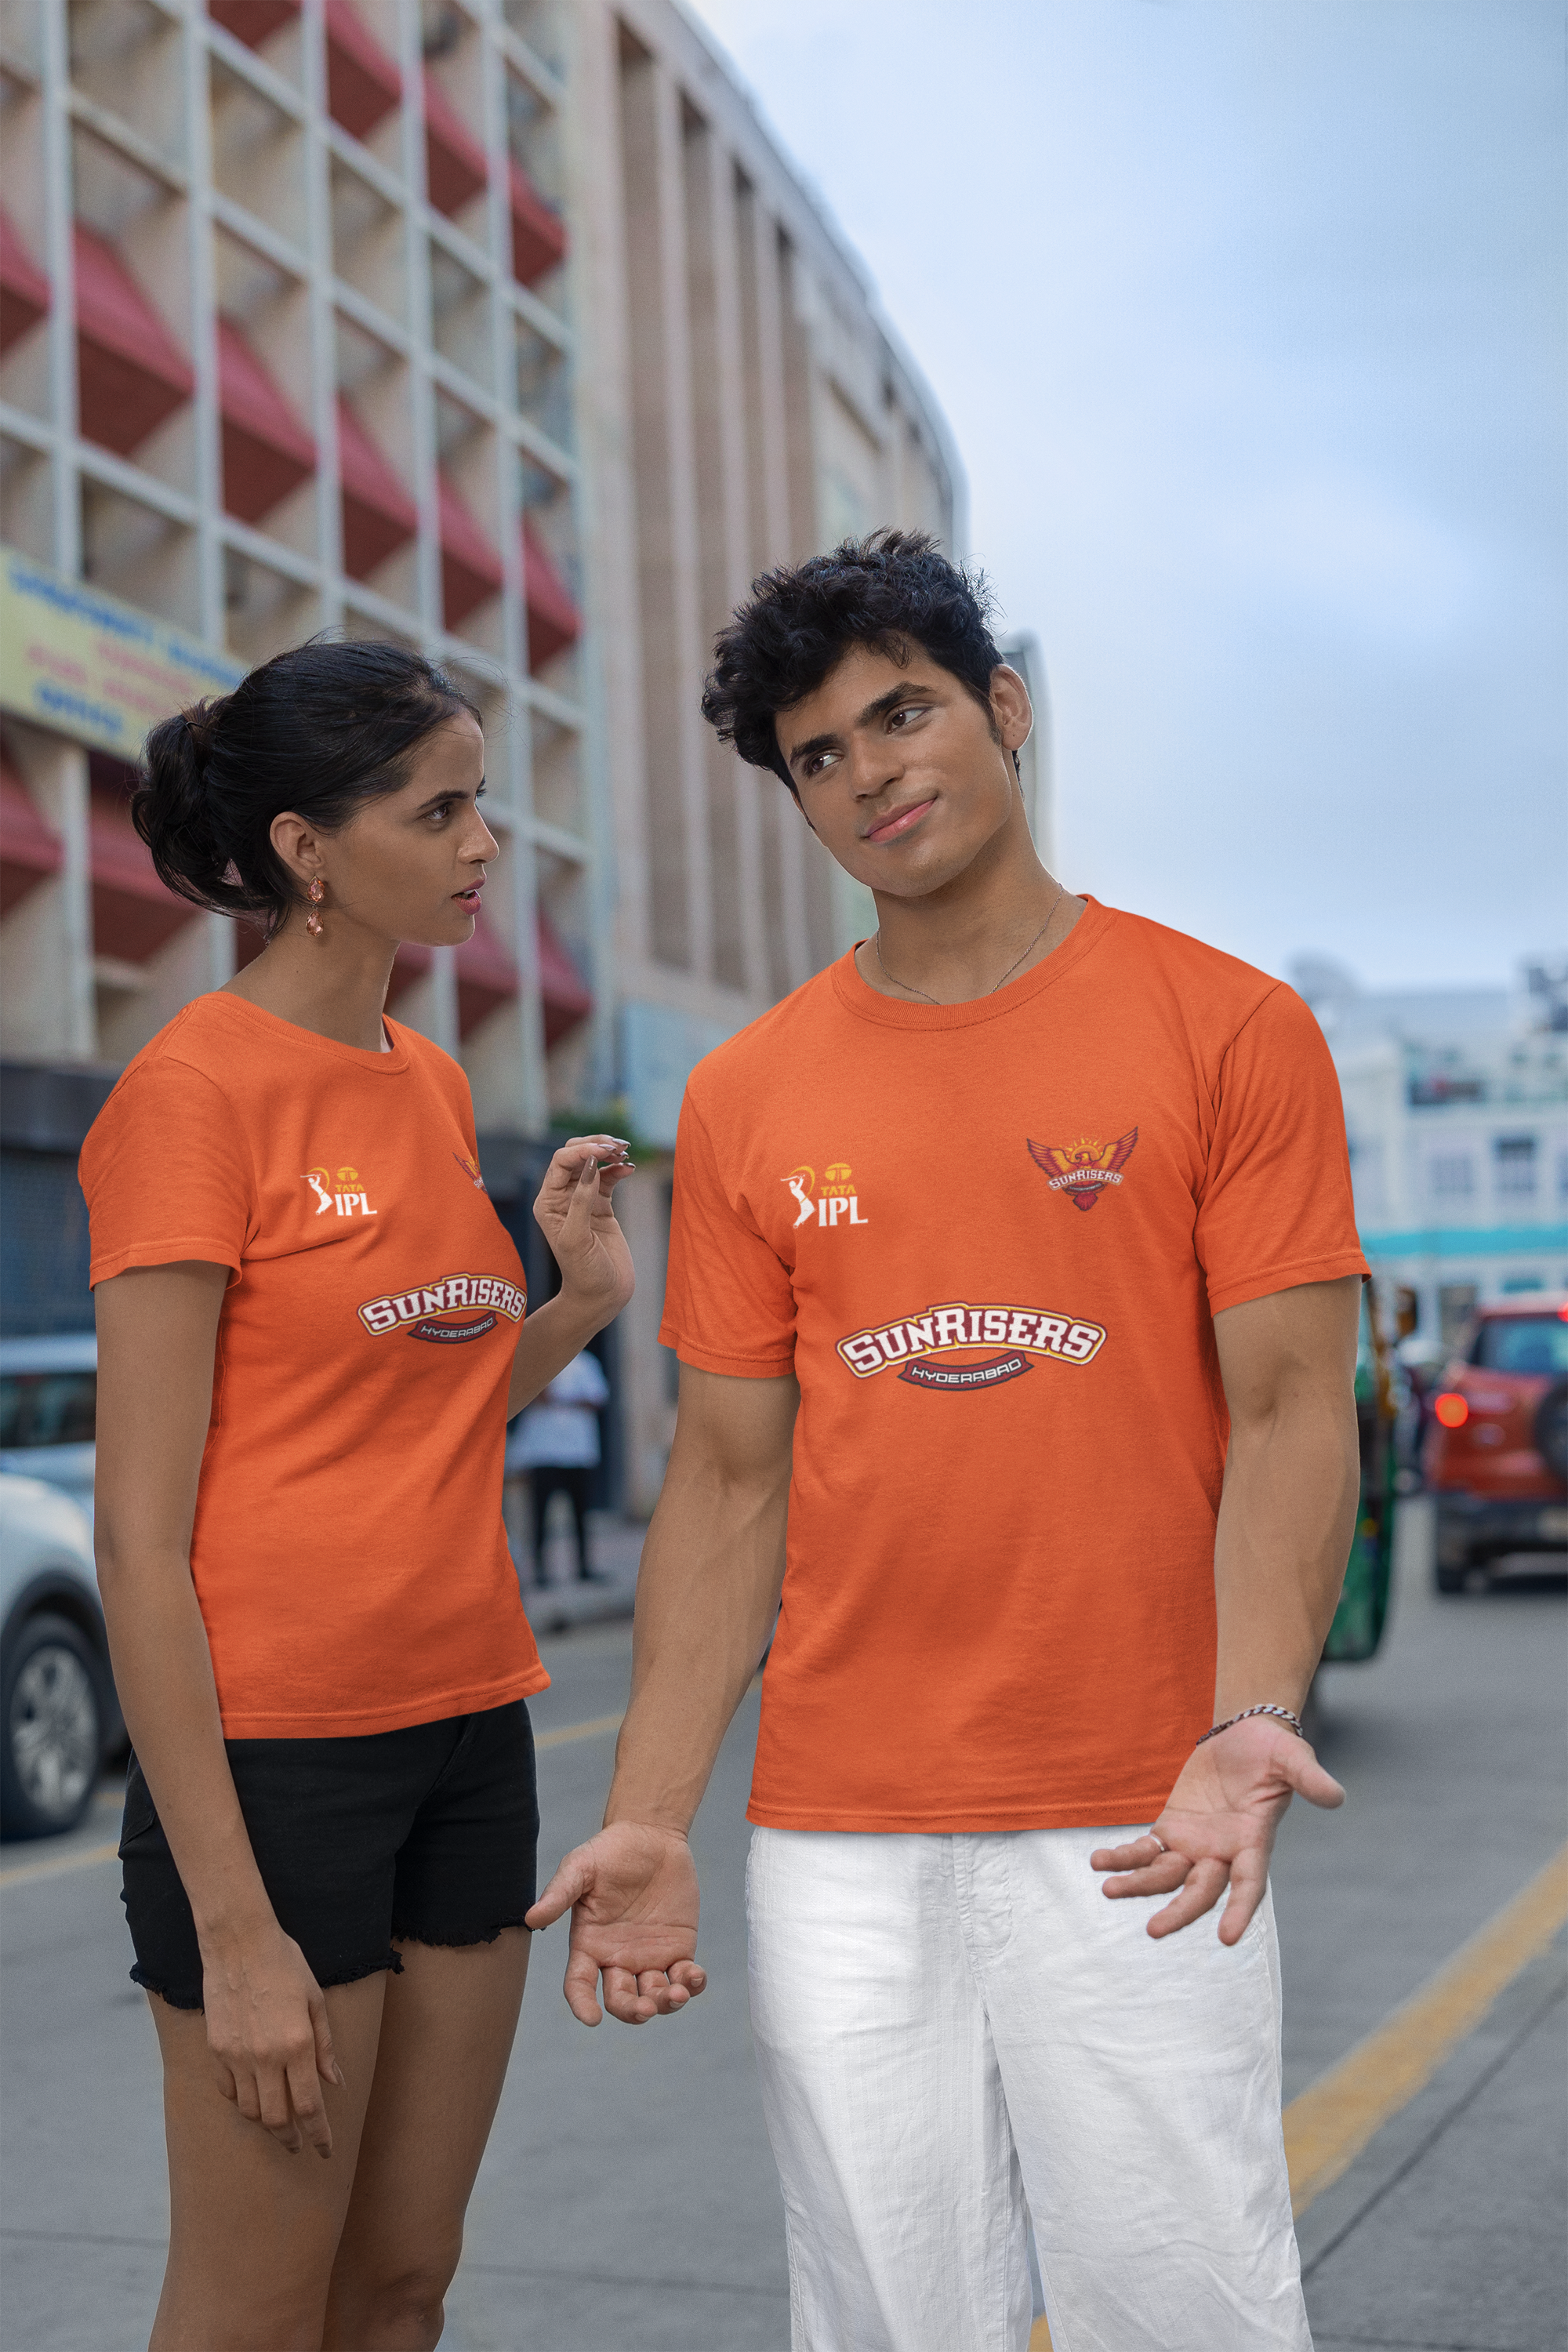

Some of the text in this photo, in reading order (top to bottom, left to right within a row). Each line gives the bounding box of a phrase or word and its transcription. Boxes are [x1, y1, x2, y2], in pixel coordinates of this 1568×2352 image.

[335, 1183, 365, 1192] TATA
[821, 1184, 856, 1196] TATA
[1049, 1170, 1122, 1189] SUNRISERS
[334, 1192, 377, 1216] IPL
[818, 1196, 868, 1227] IPL
[421, 1317, 493, 1338] HYDERABAD
[911, 1358, 1022, 1384] HYDERABAD
